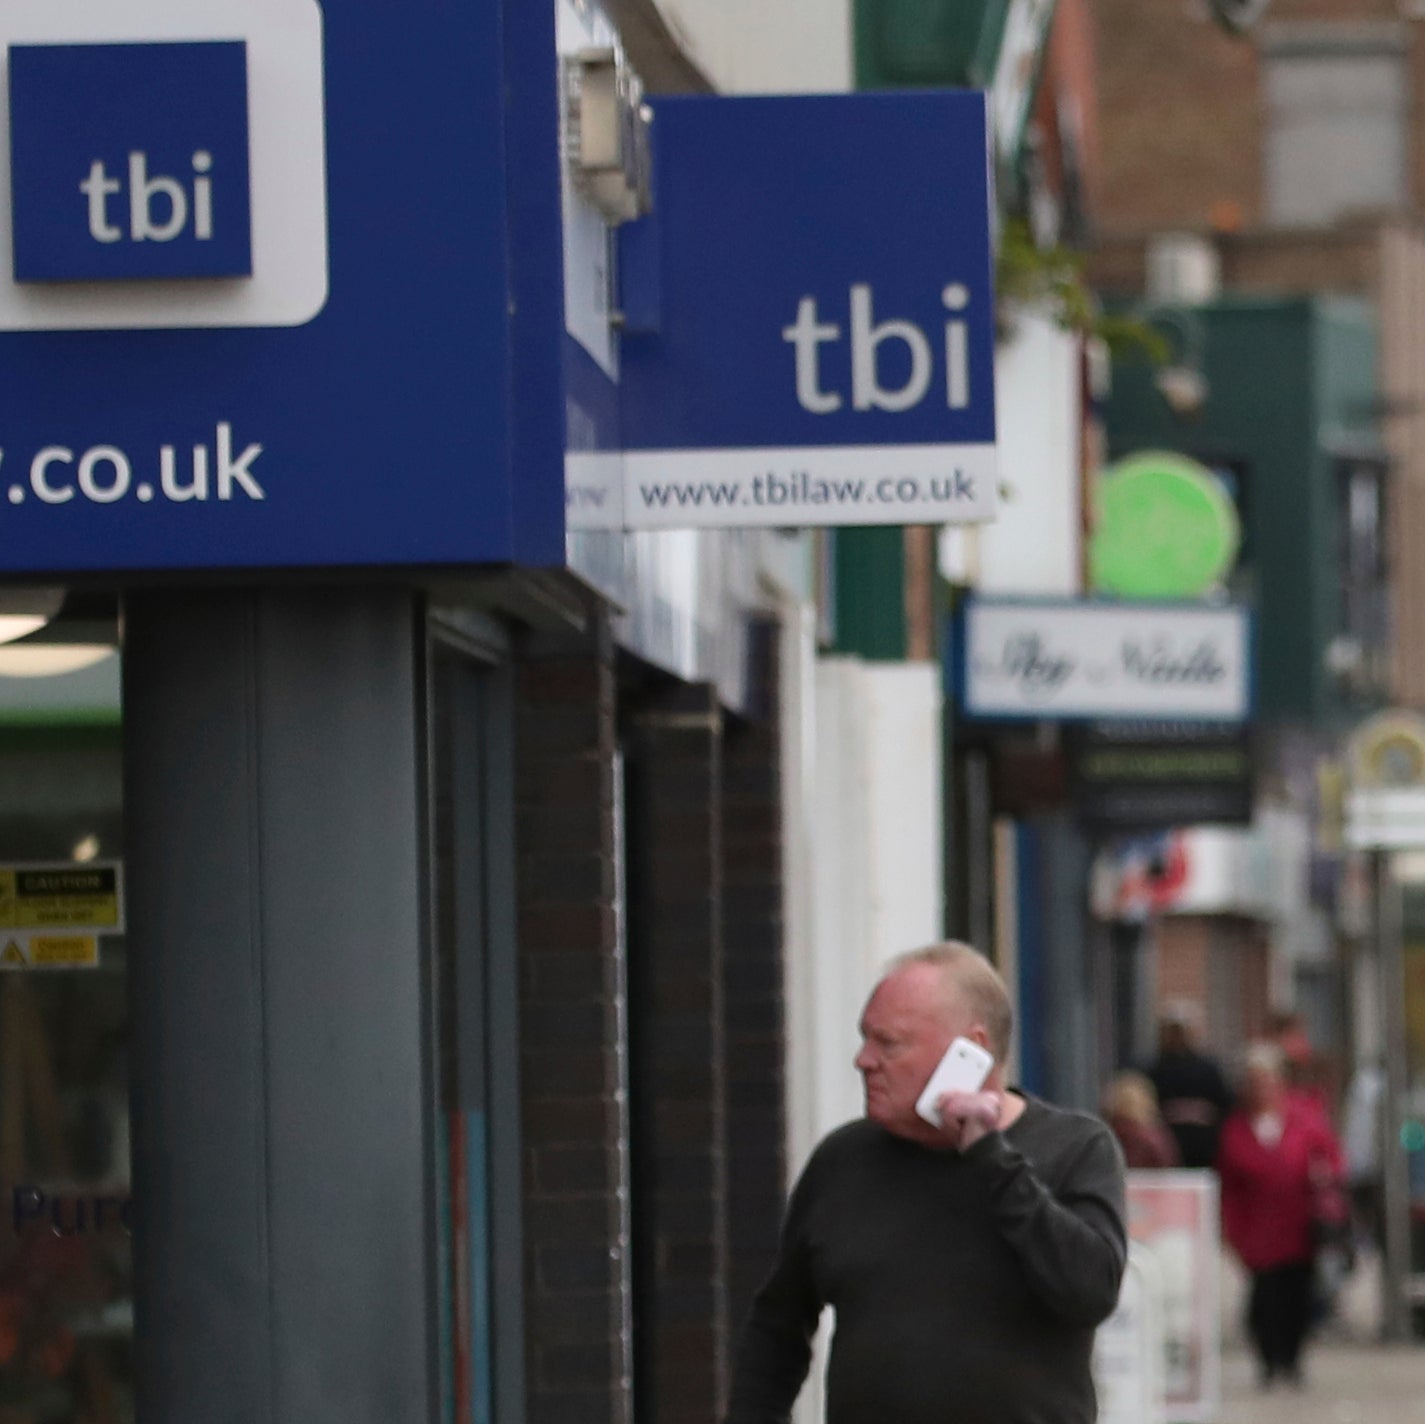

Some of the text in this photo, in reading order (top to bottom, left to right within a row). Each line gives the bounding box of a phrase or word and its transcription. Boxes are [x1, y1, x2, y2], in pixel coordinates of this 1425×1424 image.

[79, 150, 214, 244] tbi
[781, 282, 970, 415] tbi
[0, 420, 266, 504] .co.uk
[639, 468, 977, 509] www.tbilaw.co.uk
